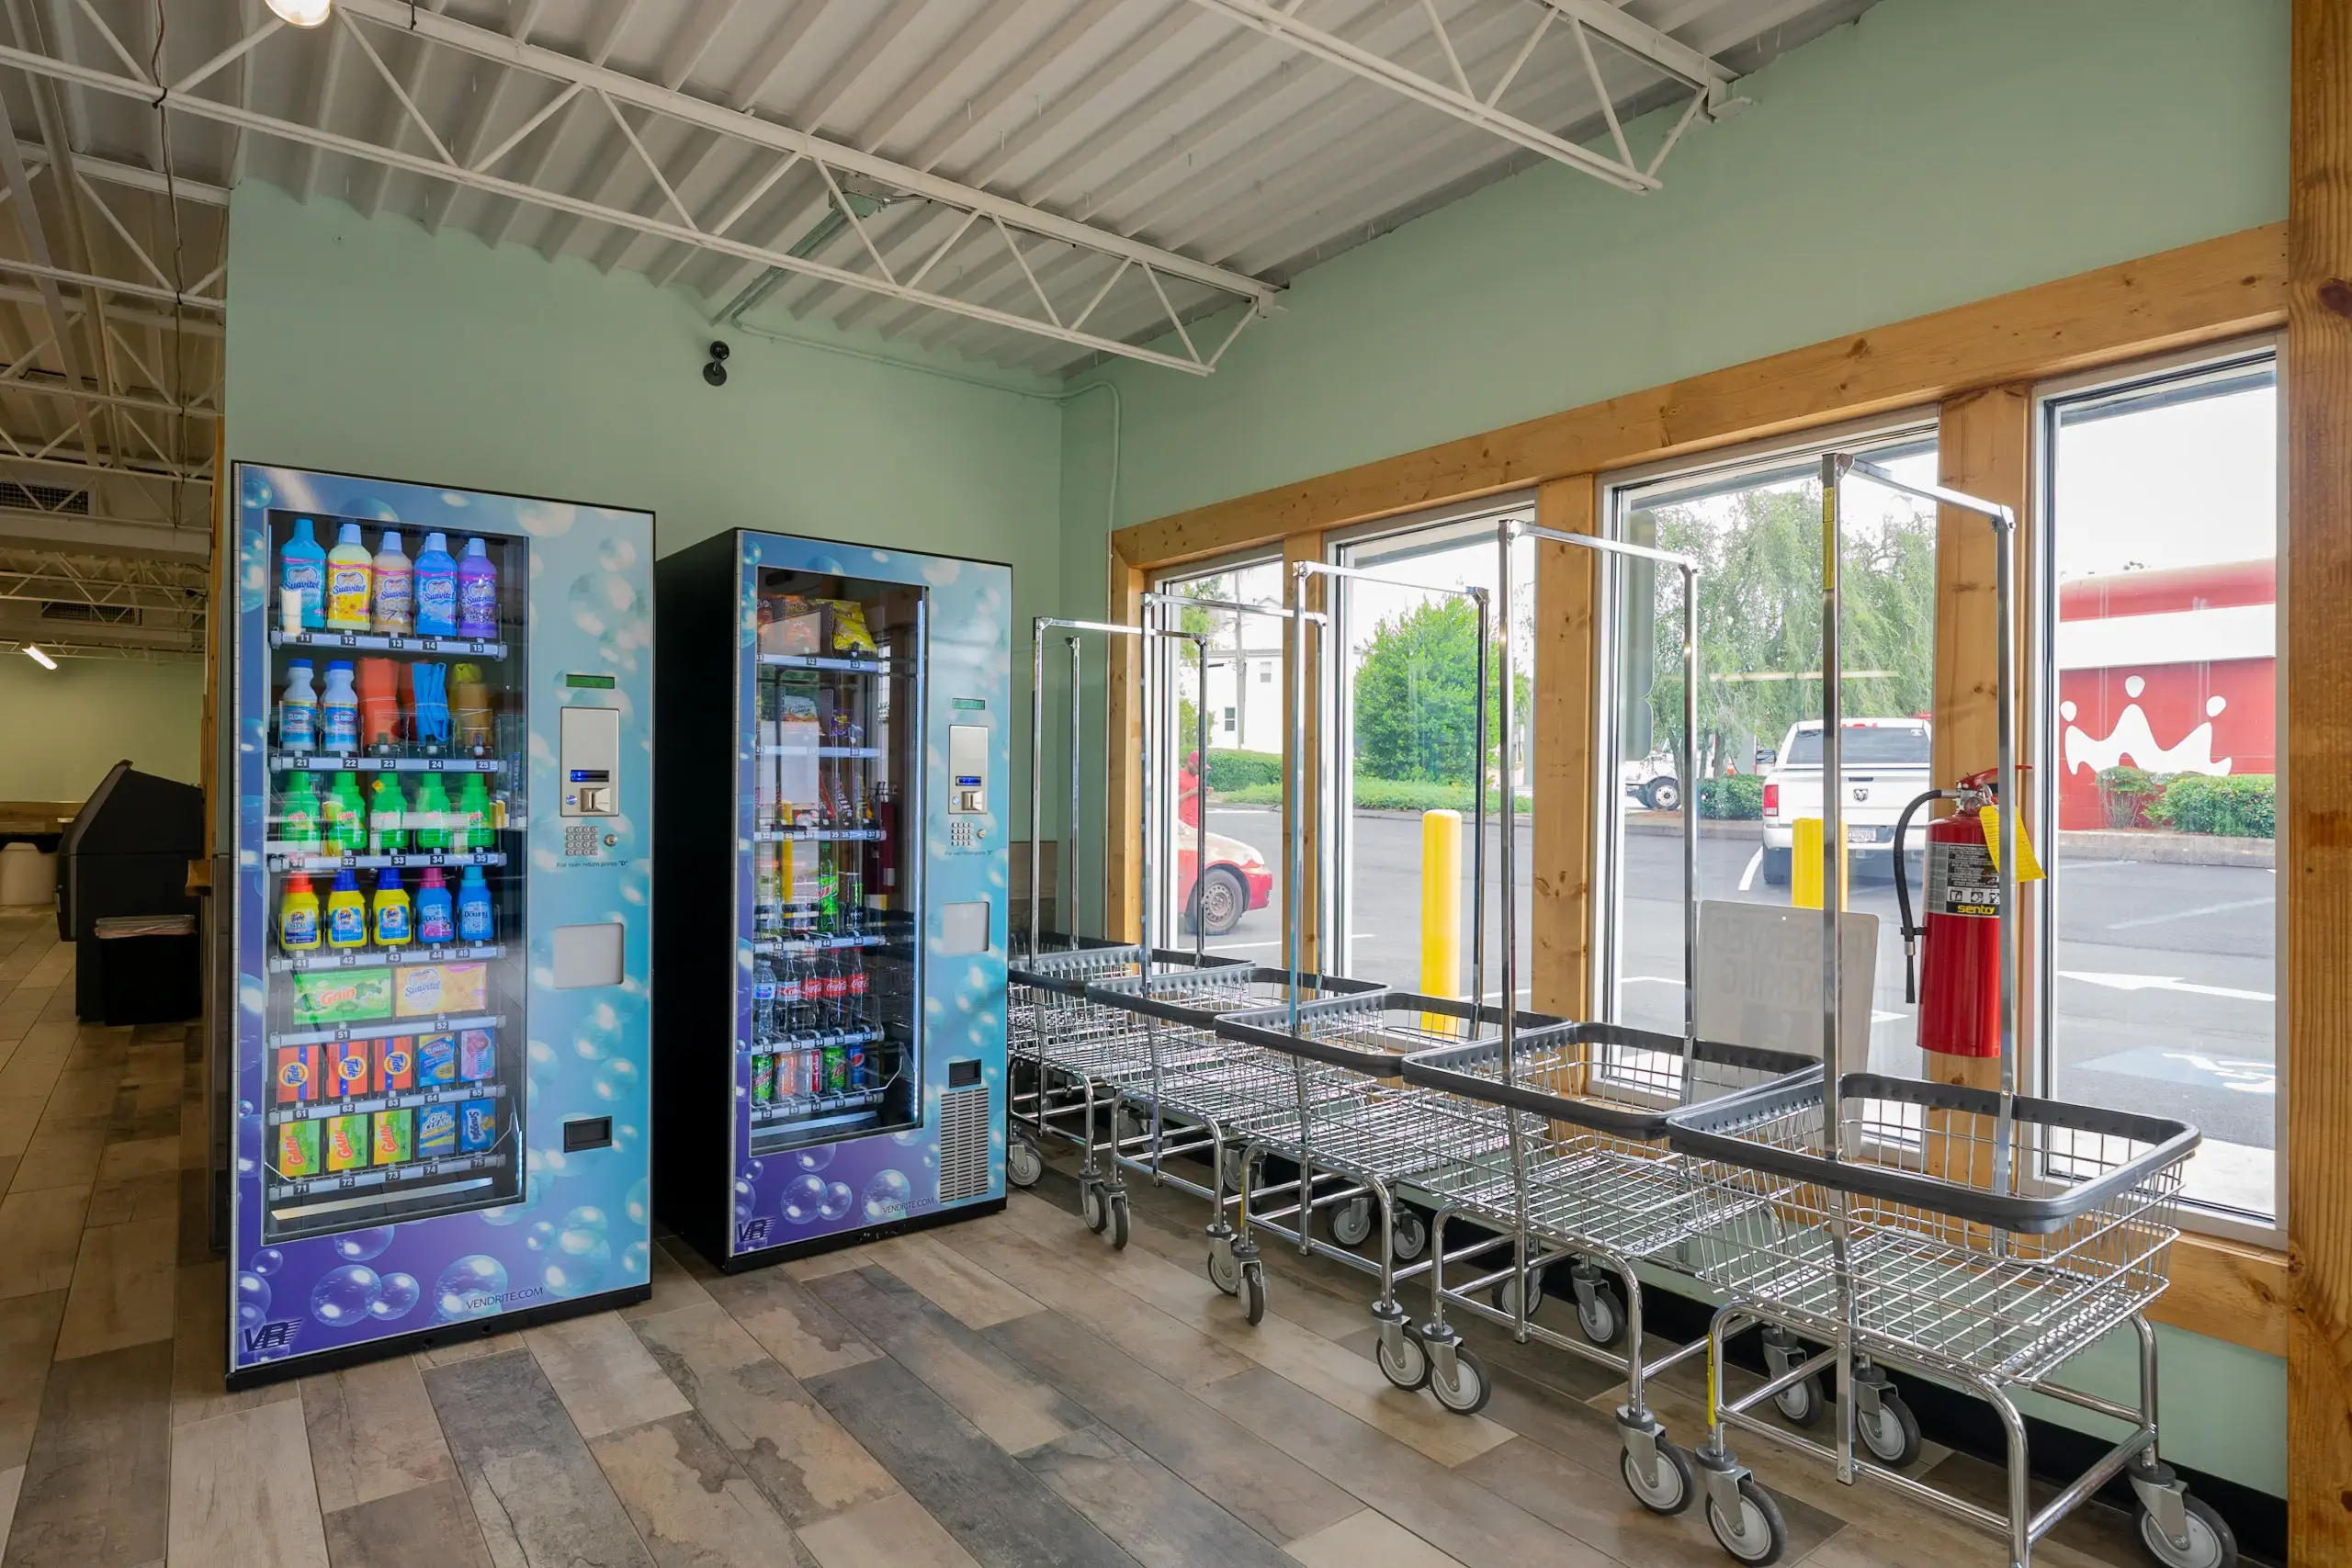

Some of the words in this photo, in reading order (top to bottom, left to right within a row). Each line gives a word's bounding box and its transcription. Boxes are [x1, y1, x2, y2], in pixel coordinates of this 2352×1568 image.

[284, 580, 321, 590] Suavitel
[333, 583, 367, 595] Suavitel
[380, 590, 411, 600] Suavitel
[424, 591, 456, 602] Suavitel
[300, 634, 310, 642] 11
[344, 637, 355, 645] 12
[391, 639, 402, 648] 13
[425, 641, 436, 649] 14
[473, 643, 483, 652] 15
[297, 759, 308, 767] 21
[345, 760, 357, 768] 22
[383, 760, 395, 768] 23
[431, 761, 443, 769] 24
[831, 829, 840, 838] 35
[867, 829, 876, 838] 37
[292, 858, 303, 867] 31
[343, 858, 356, 866] 32
[393, 856, 404, 864] 33
[432, 855, 444, 863] 34
[476, 854, 486, 863] 35
[464, 909, 488, 919] Downy
[1957, 904, 1996, 915] sentry
[291, 912, 306, 922] Tide
[337, 911, 352, 921] Tide
[425, 915, 448, 923] Downy
[821, 939, 831, 947] 44
[855, 936, 863, 944] 45
[389, 953, 400, 962] 43
[432, 951, 442, 959] 44
[459, 949, 469, 957] 45
[296, 959, 307, 968] 41
[343, 956, 355, 965] 42
[404, 981, 441, 997] Suavitel
[321, 987, 356, 1006] Gain
[436, 1021, 447, 1030] 52
[338, 1030, 349, 1040] 51
[764, 1043, 774, 1052] 52
[815, 1039, 824, 1047] 54
[344, 1058, 360, 1078] Tide
[390, 1054, 405, 1073] Tide
[286, 1065, 302, 1086] Tide
[388, 1099, 399, 1107] 63
[342, 1105, 354, 1113] 62
[296, 1110, 307, 1118] 61
[469, 1111, 481, 1140] Snuggle
[426, 1166, 436, 1174] 74
[388, 1171, 398, 1179] 73
[342, 1179, 353, 1187] 72
[882, 1197, 935, 1214] VENDRITE.COM
[466, 1286, 544, 1310] VENDRITE.COM
